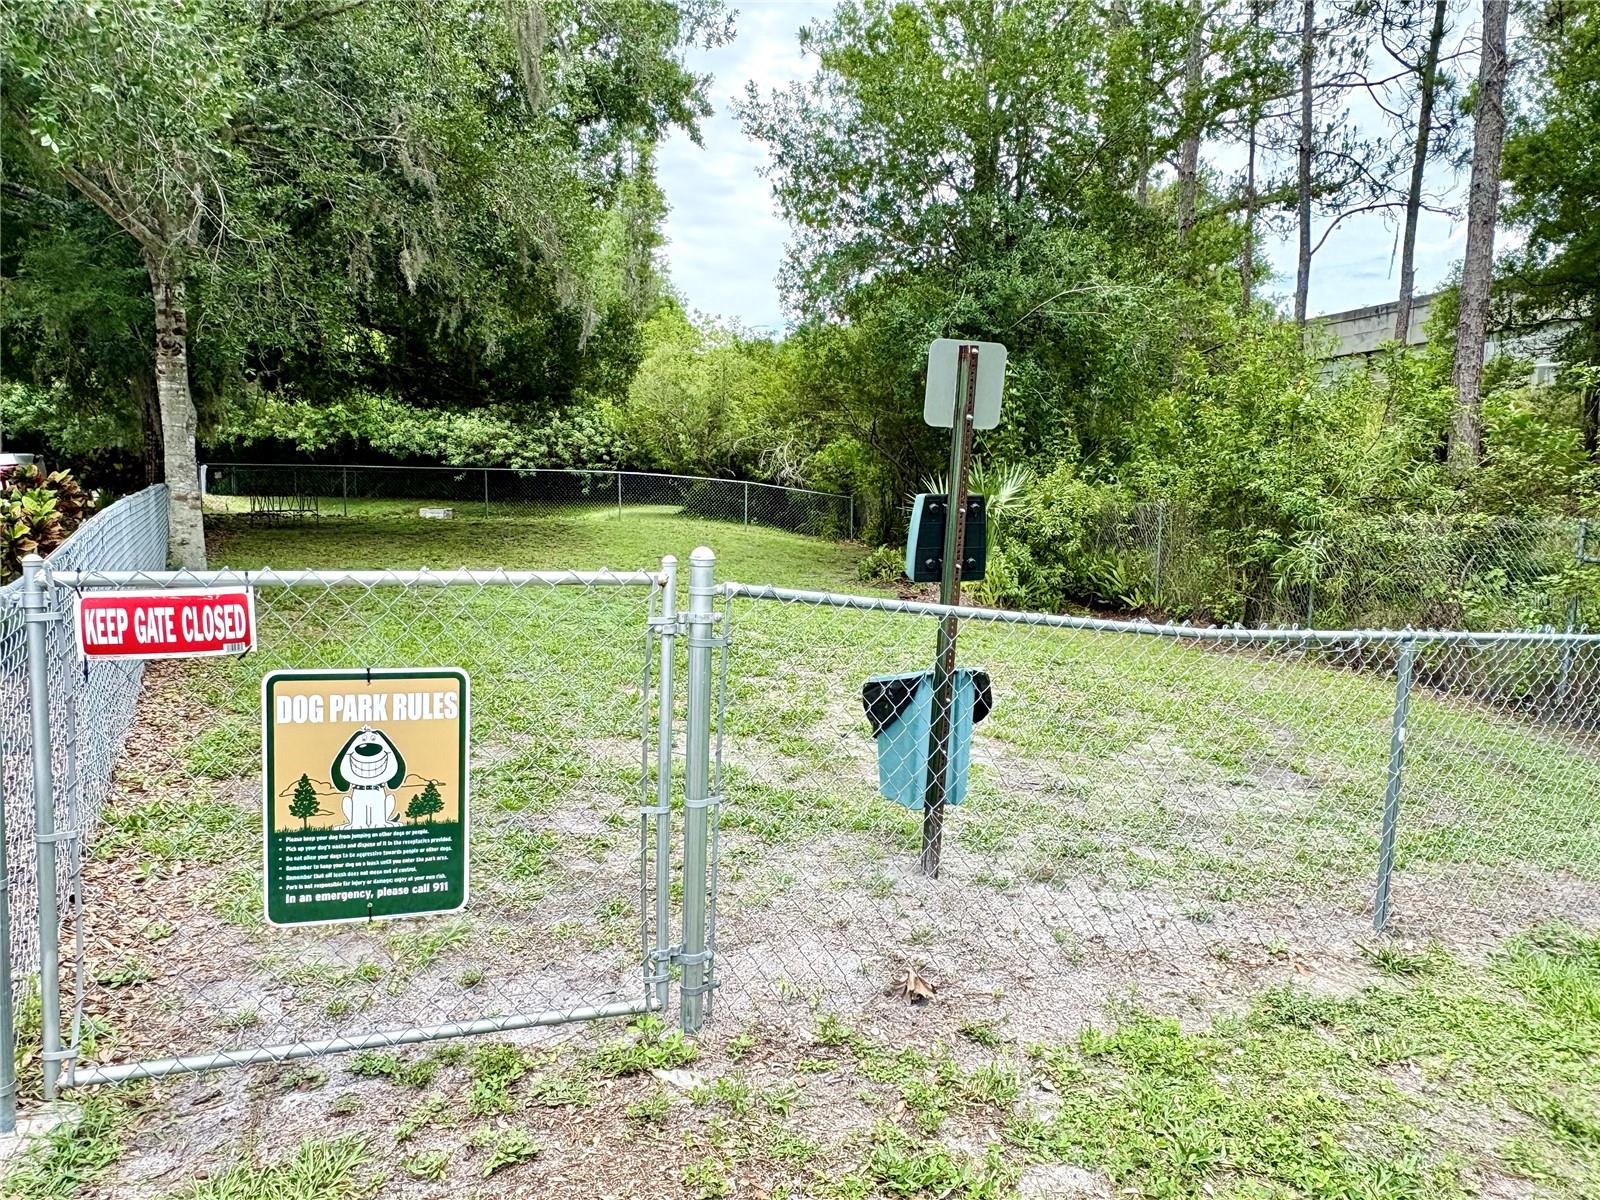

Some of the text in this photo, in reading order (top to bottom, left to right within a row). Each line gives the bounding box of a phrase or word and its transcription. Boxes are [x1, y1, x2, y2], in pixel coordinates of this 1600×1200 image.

[84, 604, 246, 645] KEEP GATE CLOSED
[276, 692, 458, 724] DOG PARK RULES
[285, 882, 448, 903] In an emergency, please call 911
